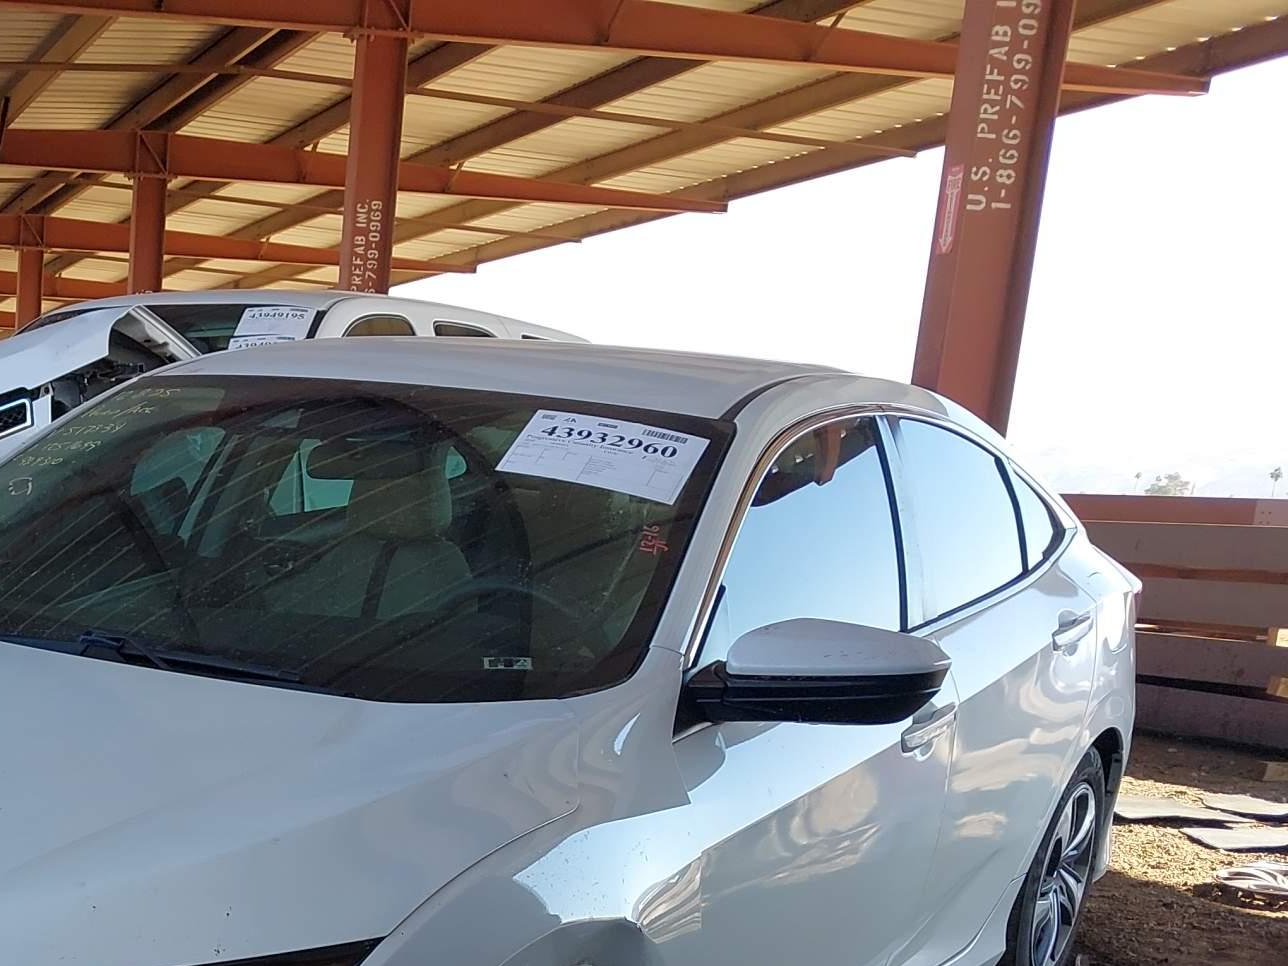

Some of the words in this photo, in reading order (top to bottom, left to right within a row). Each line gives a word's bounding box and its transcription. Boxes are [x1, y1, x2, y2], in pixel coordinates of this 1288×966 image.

[976, 23, 1012, 139] PREFAB
[966, 158, 993, 211] U.S.
[355, 199, 369, 228] INC.
[541, 425, 678, 458] 43932960
